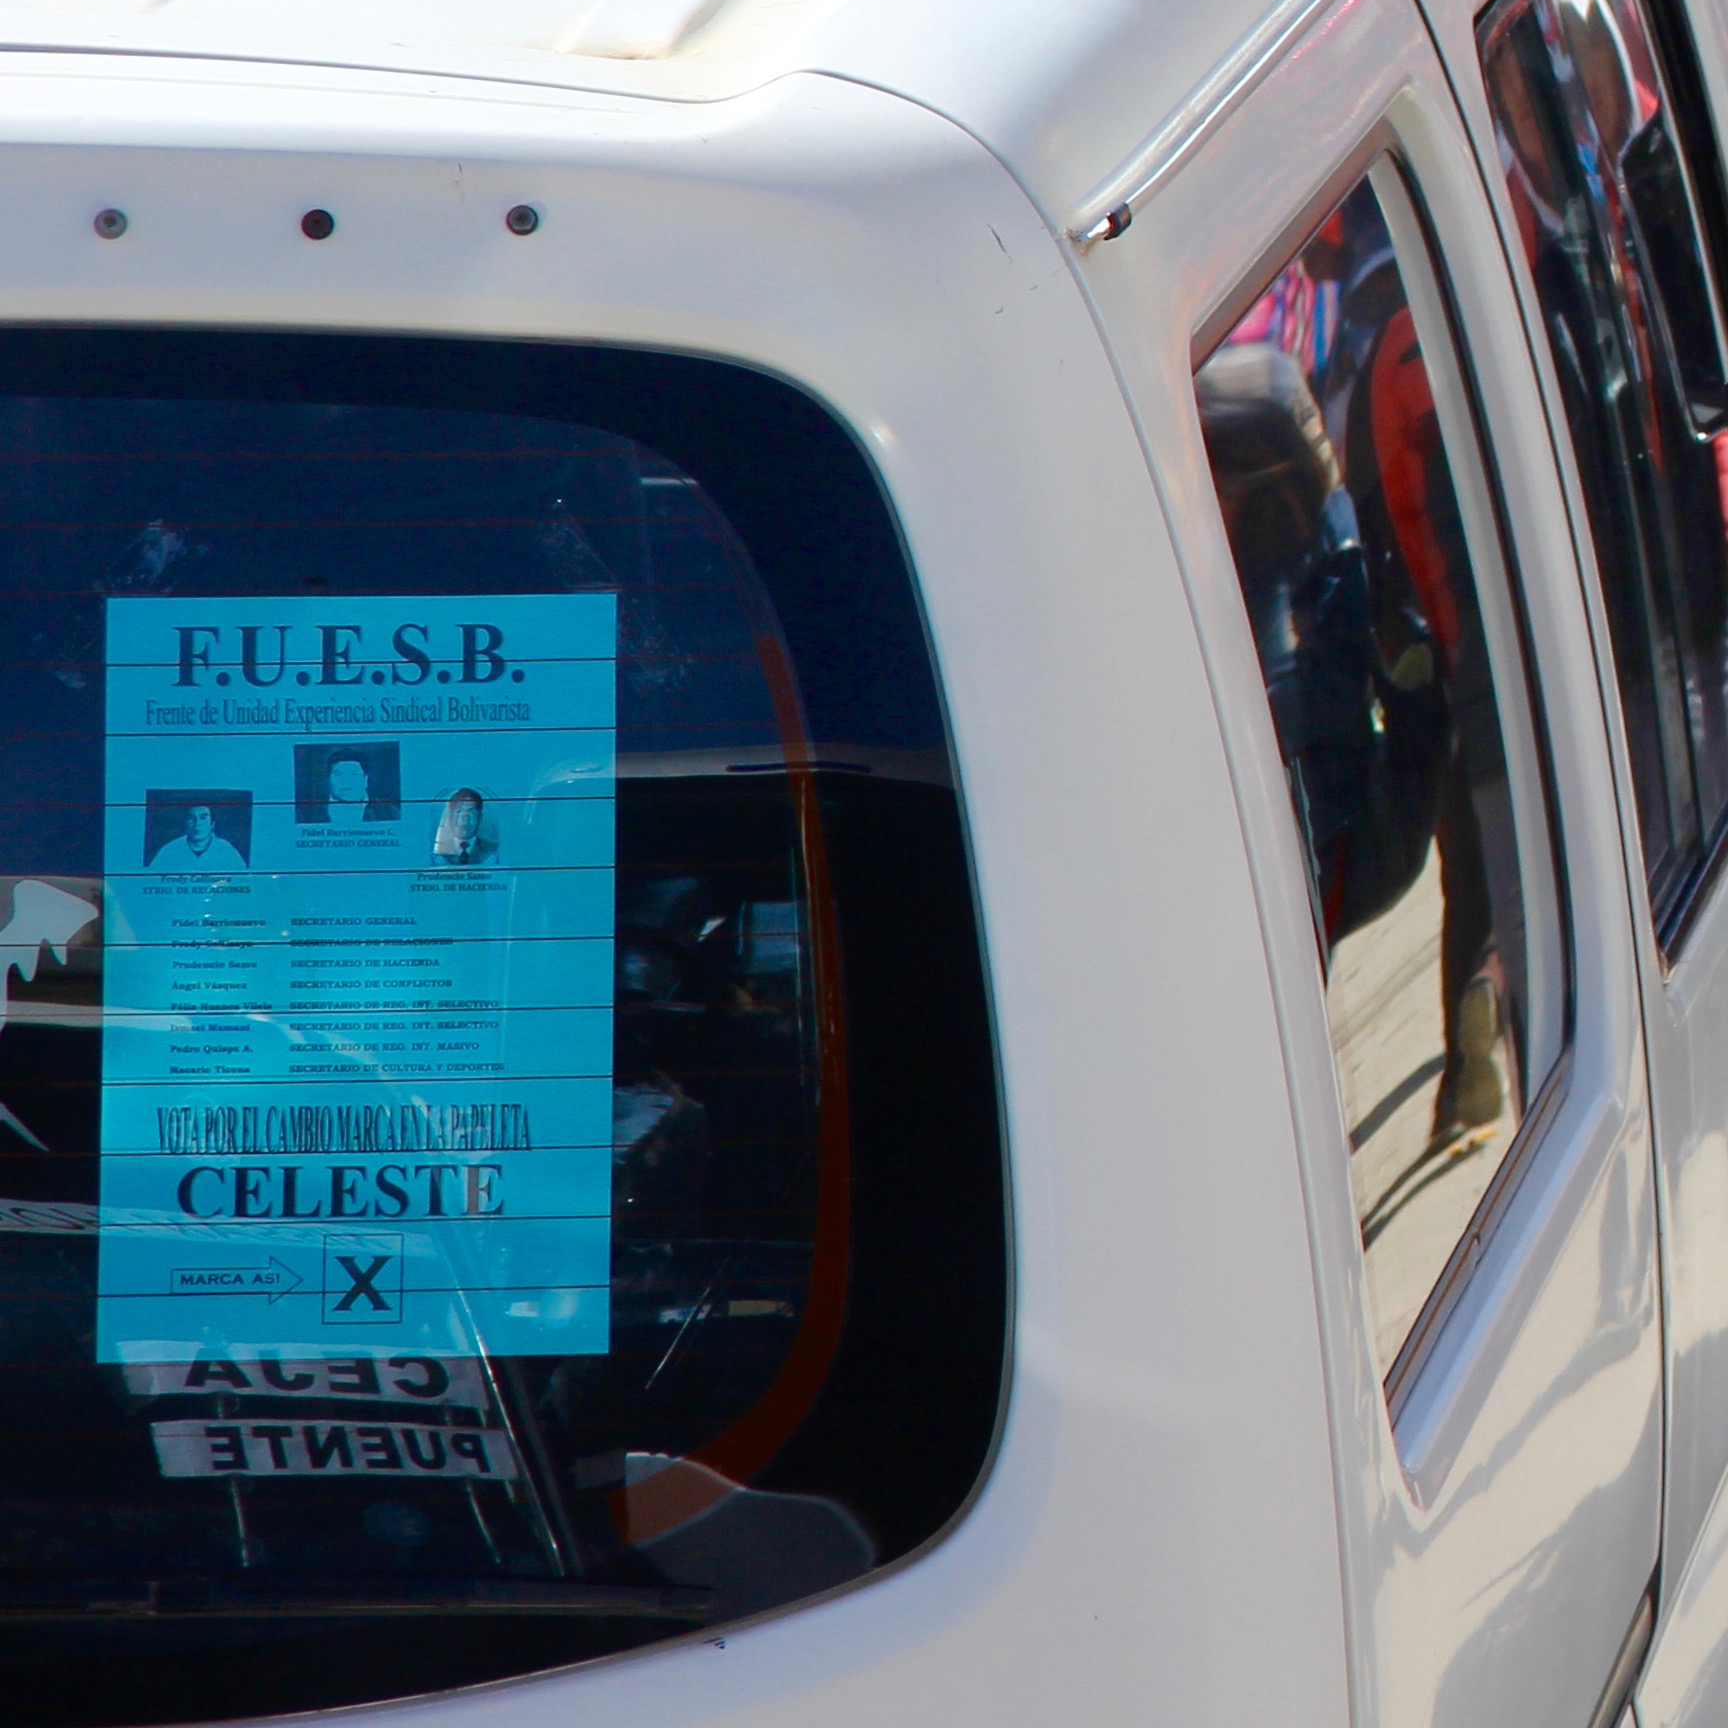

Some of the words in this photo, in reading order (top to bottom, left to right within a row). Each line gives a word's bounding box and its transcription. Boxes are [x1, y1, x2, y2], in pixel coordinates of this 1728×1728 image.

[171, 623, 526, 688] F.U.E.S.B.
[146, 698, 196, 726] Frente
[200, 698, 217, 725] de
[223, 697, 279, 725] Unidad
[285, 697, 375, 731] Experiencia
[380, 696, 442, 724] Sindical
[448, 695, 529, 723] Bolivarista
[295, 839, 356, 848] SECRETARIO
[357, 839, 401, 848] GENERAL
[177, 886, 190, 894] DE
[192, 885, 251, 894] RELACIONES
[444, 883, 455, 891] DE
[459, 883, 507, 892] HACIENDA
[172, 918, 199, 927] Fidel
[290, 918, 361, 926] SECRETARIO
[365, 917, 417, 926] GENERAL
[290, 959, 361, 968] SECRETARIO
[365, 959, 382, 967] DE
[384, 958, 440, 967] HACIENDA
[290, 980, 361, 989] SECRETARIO
[365, 980, 381, 988] DE
[383, 979, 452, 988] CONFLICTOS
[289, 1001, 362, 1010] SECRETARIO
[364, 1000, 381, 1009] DE
[437, 999, 499, 1008] SELECTIVO
[289, 1023, 361, 1031] SECRETARIO
[364, 1022, 381, 1031] DE
[437, 1021, 499, 1030] SELECTIVO
[169, 1043, 200, 1053] Pedro
[289, 1043, 361, 1052] SECRETARIO
[364, 1043, 380, 1051] DE
[436, 1041, 480, 1050] MASIVO
[289, 1064, 361, 1073] SECRETARIO
[363, 1064, 381, 1072] DE
[381, 1063, 433, 1072] CULTURA
[436, 1063, 443, 1071] Y
[446, 1062, 505, 1071] DEPORTES
[157, 1106, 199, 1154] VOTA
[205, 1106, 238, 1154] POR
[242, 1106, 262, 1153] EL
[265, 1105, 333, 1153] CAMBIO
[336, 1104, 396, 1152] MARCA
[400, 1104, 421, 1151] EN
[424, 1104, 445, 1151] LA
[450, 1103, 530, 1150] PAPELETA
[177, 1163, 504, 1219] CELESTE
[180, 1273, 245, 1286] MARCA
[332, 1254, 394, 1312] X
